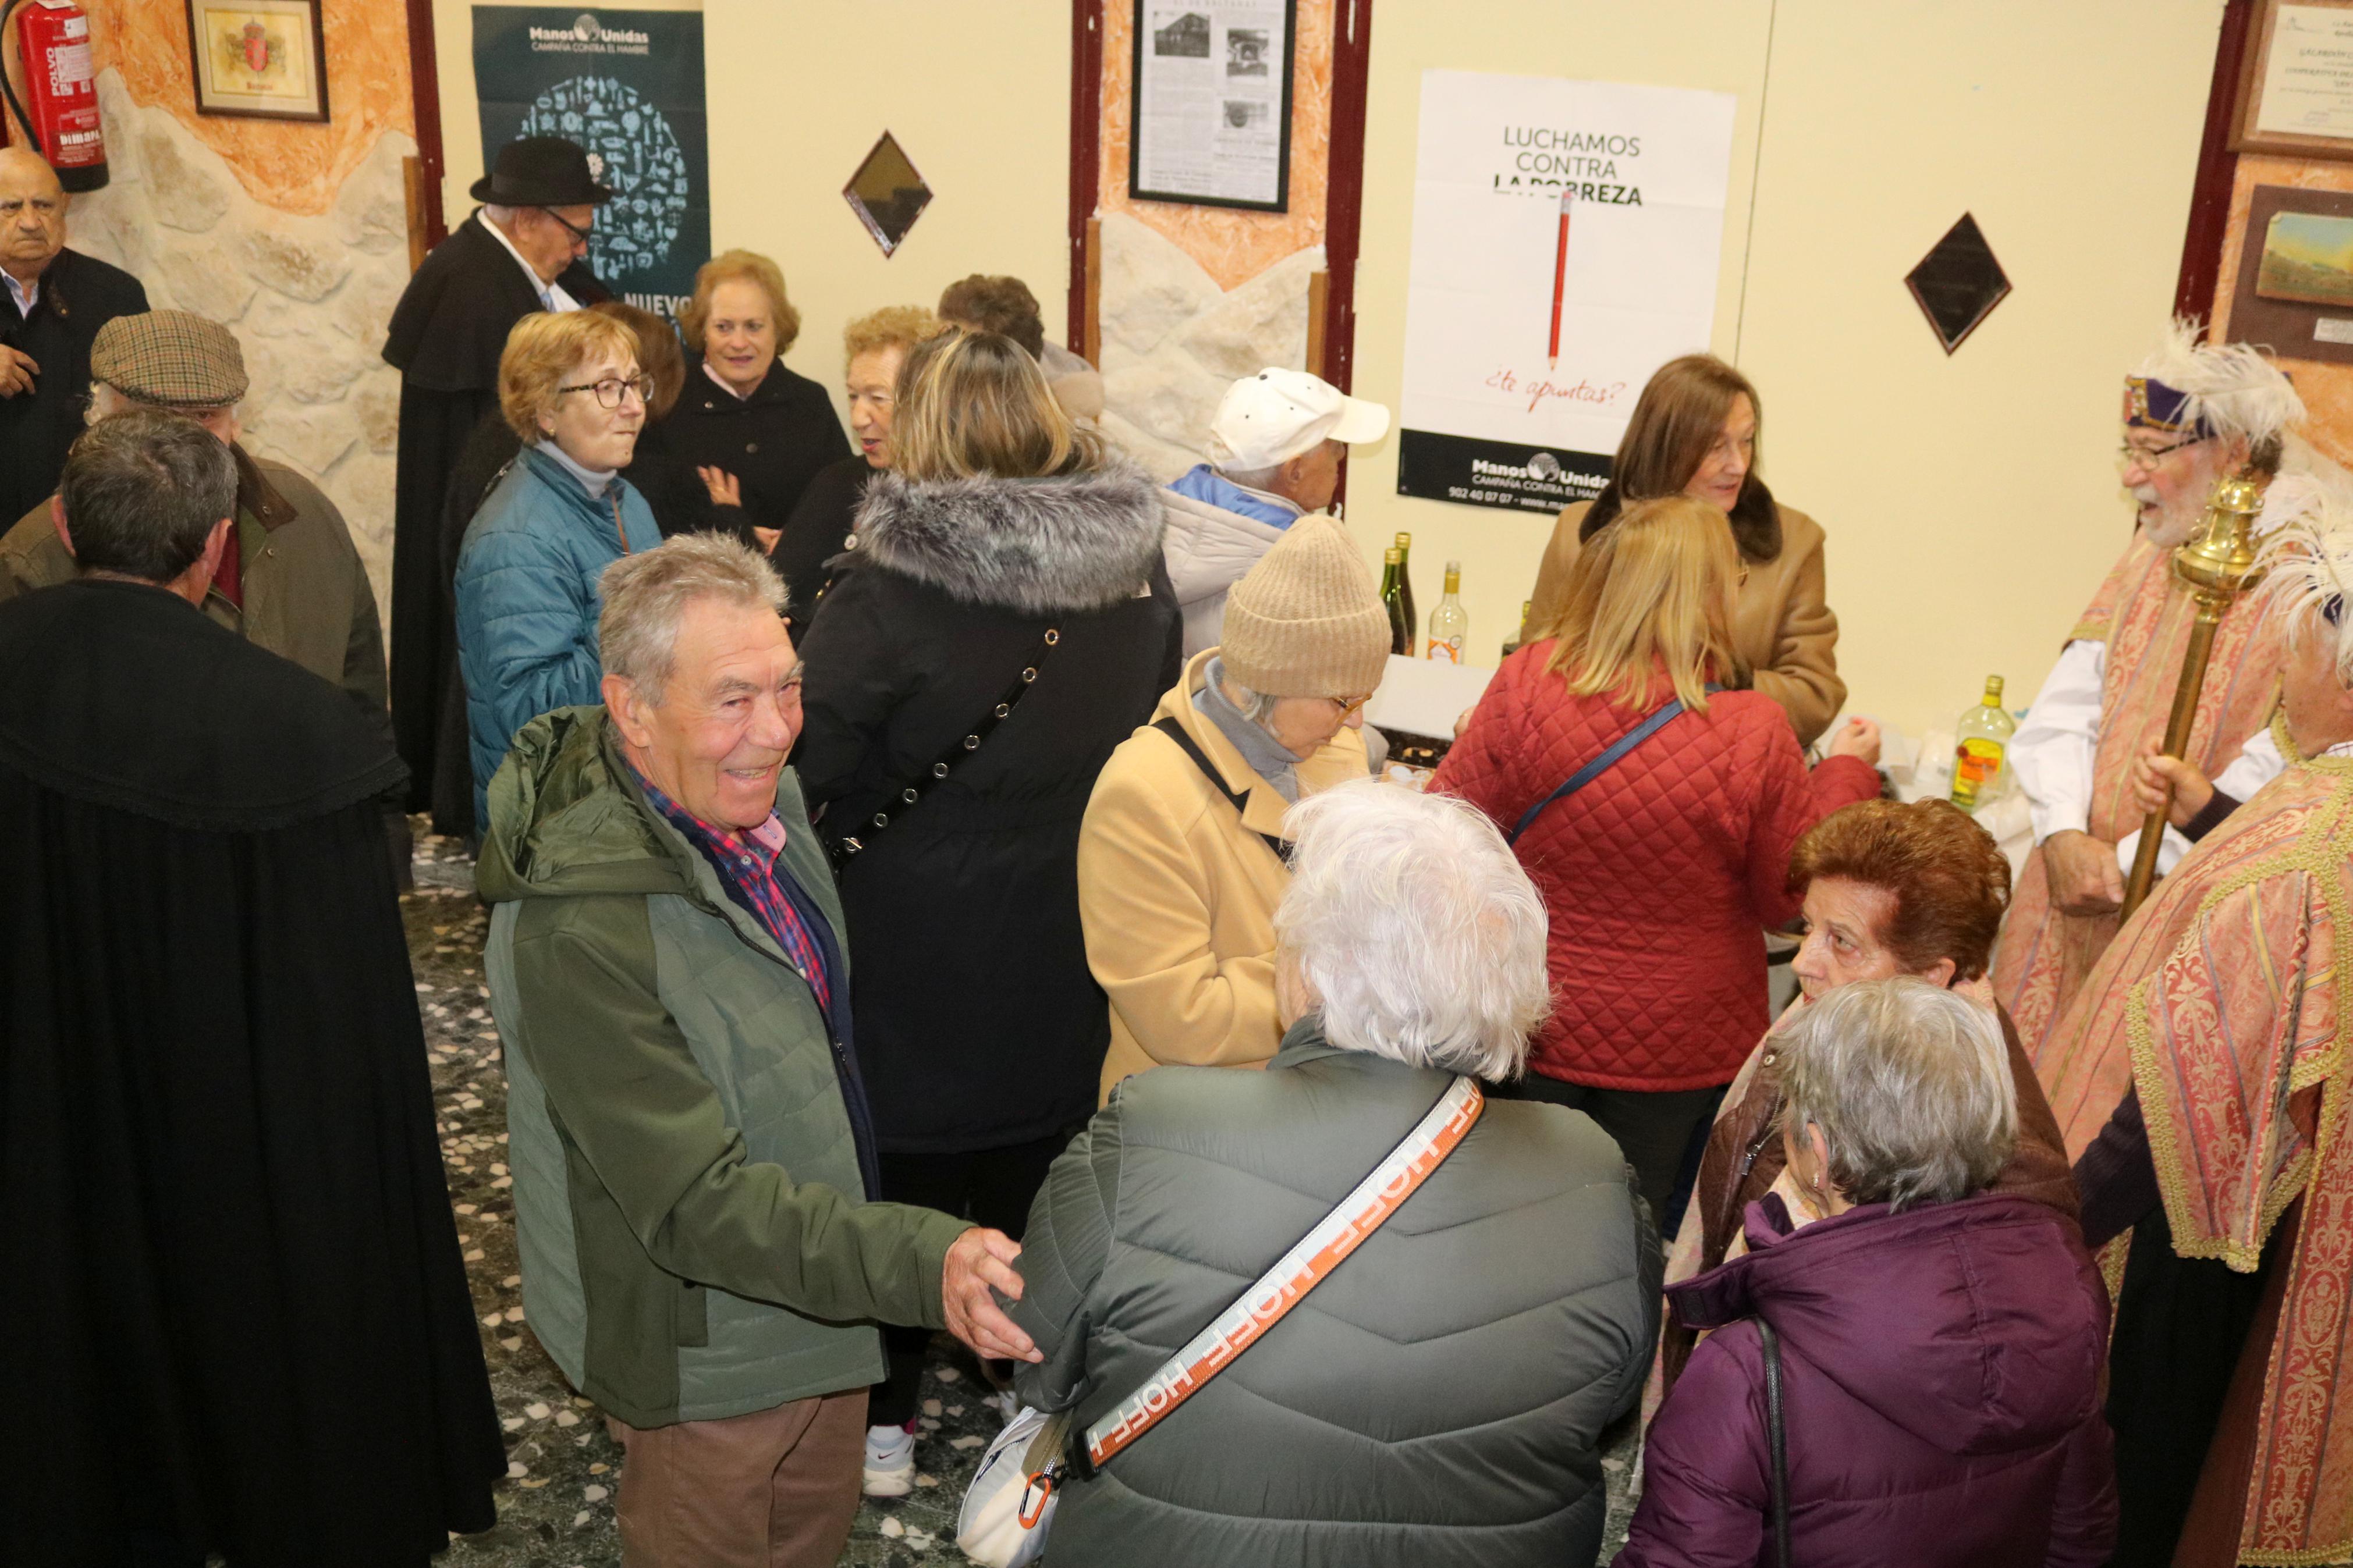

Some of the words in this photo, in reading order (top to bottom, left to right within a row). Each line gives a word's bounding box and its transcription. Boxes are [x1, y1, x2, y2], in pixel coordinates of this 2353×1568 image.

[530, 27, 574, 41] Manos
[601, 29, 649, 44] Unidas
[45, 47, 61, 97] POLVO
[1503, 126, 1641, 157] LUCHAMOS
[1516, 151, 1617, 179] CONTRA
[624, 291, 693, 317] NUEVO
[1485, 369, 1517, 392] ¿te
[1526, 379, 1627, 413] apuntas?
[1472, 458, 1528, 479] Manos
[1560, 469, 1611, 490] Unida
[1472, 474, 1521, 490] CAMPAÑA
[1522, 480, 1564, 495] CONTRA
[1564, 485, 1575, 497] EL
[1576, 487, 1602, 500] HAM
[1448, 486, 1468, 499] 902
[1468, 489, 1484, 501] 40
[1484, 490, 1499, 503] 07
[1498, 492, 1513, 504] 07
[1520, 497, 1571, 511] www.ma
[1445, 1075, 1481, 1135] OFF
[1333, 1132, 1439, 1254] HOFF
[1208, 1253, 1315, 1367] HOFF
[1111, 1360, 1194, 1444] HOFF
